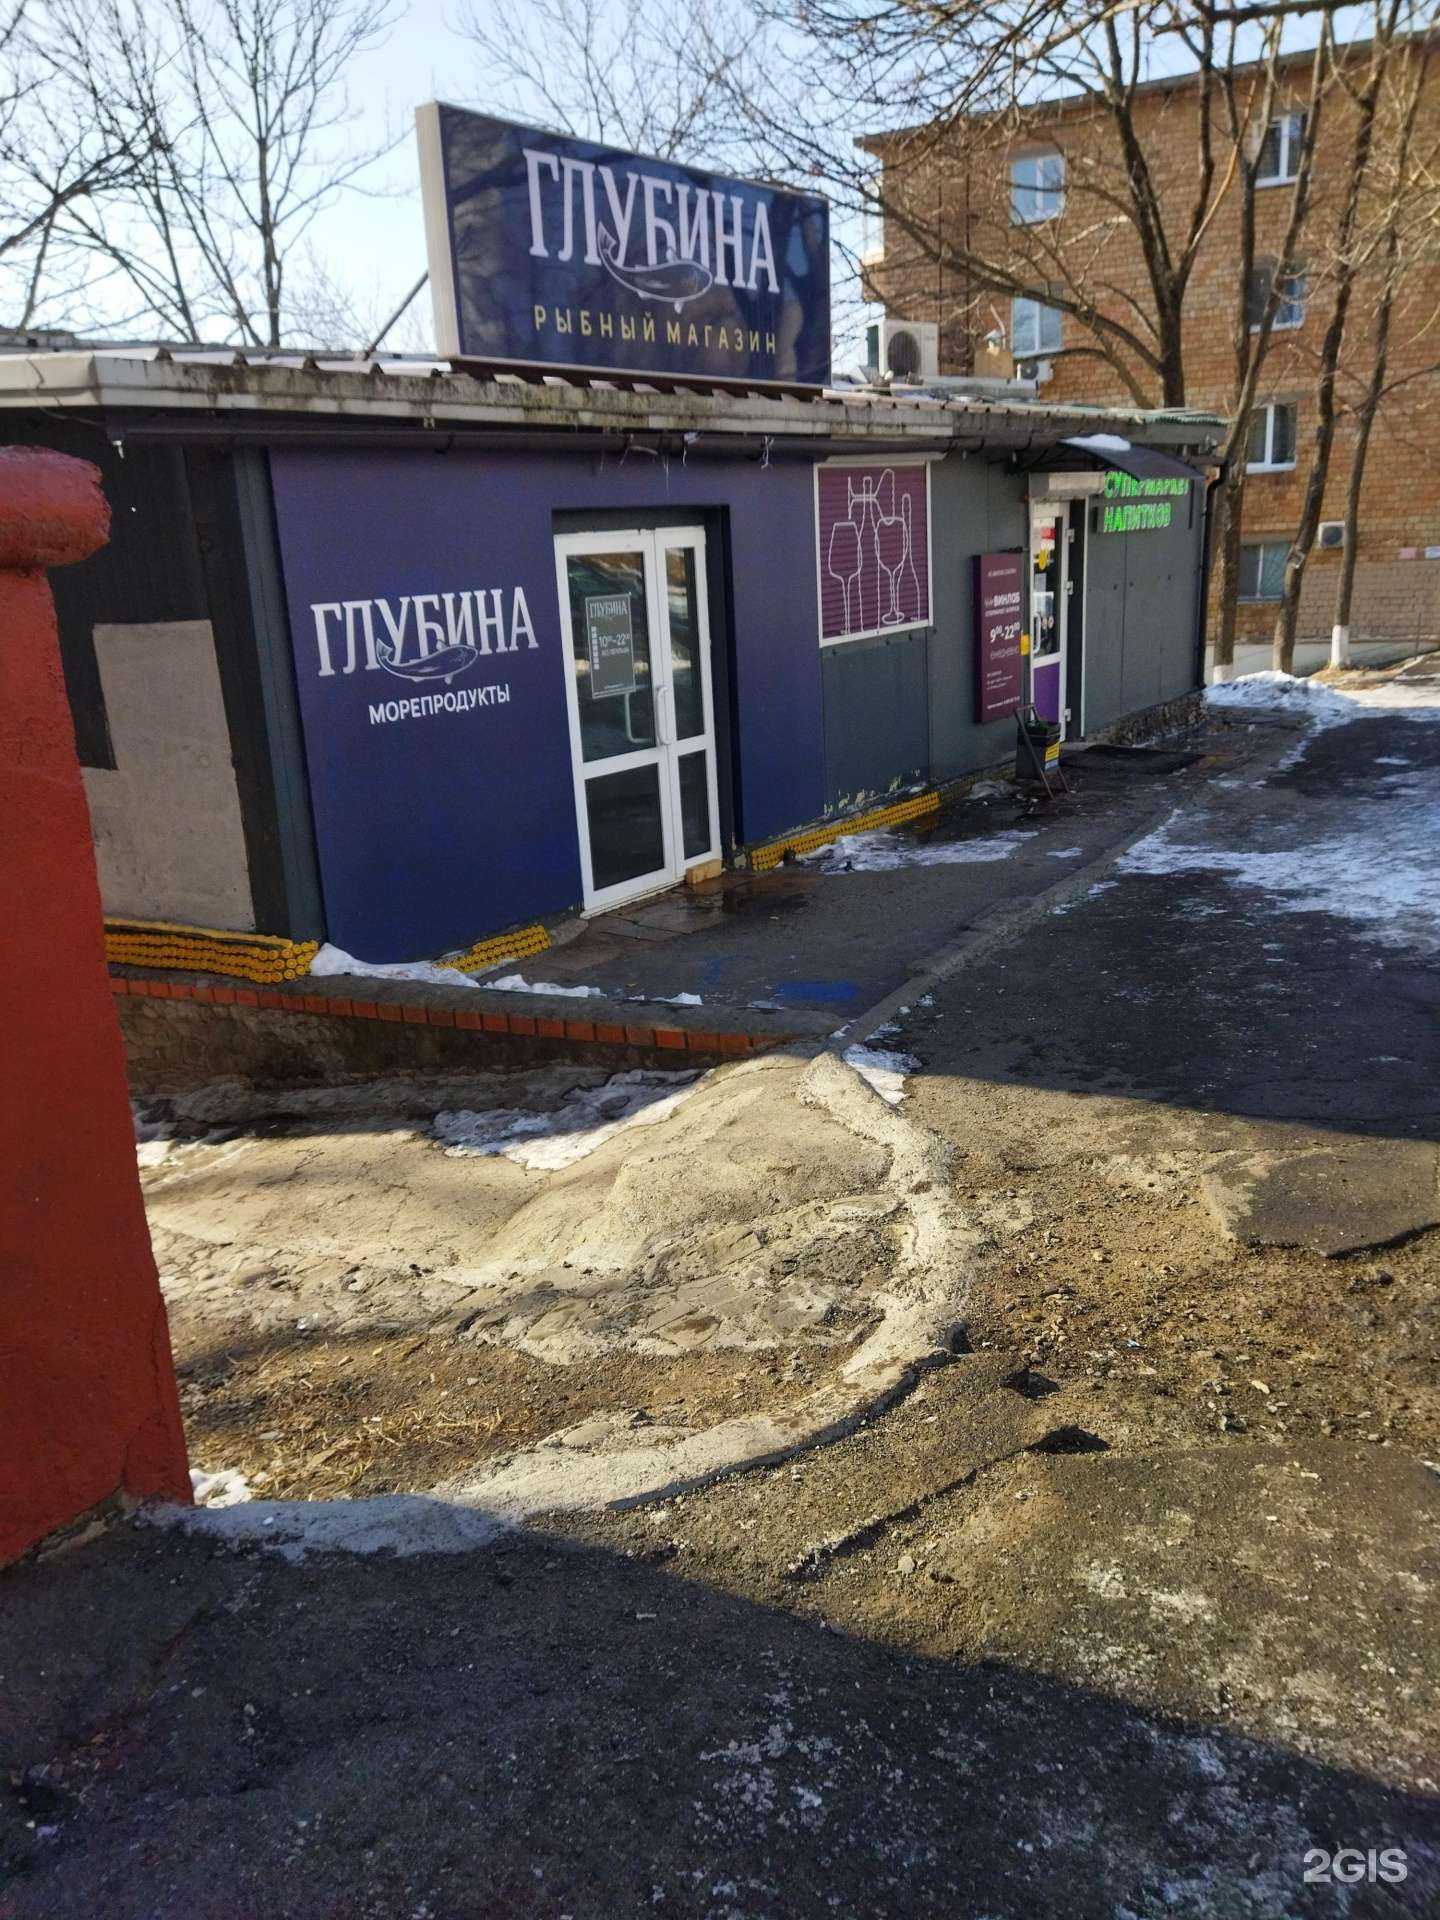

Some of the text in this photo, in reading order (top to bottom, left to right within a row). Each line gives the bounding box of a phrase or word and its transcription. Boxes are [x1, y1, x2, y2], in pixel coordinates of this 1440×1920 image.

[523, 147, 780, 294] ГЛУБИНА
[535, 304, 777, 355] РЫБНЫЙ МАГАЗИН
[1104, 502, 1172, 532] НАПИТКОВ
[310, 586, 539, 676] ГЛУБИНА
[369, 684, 511, 724] МОРЕПРОДУКТЫ
